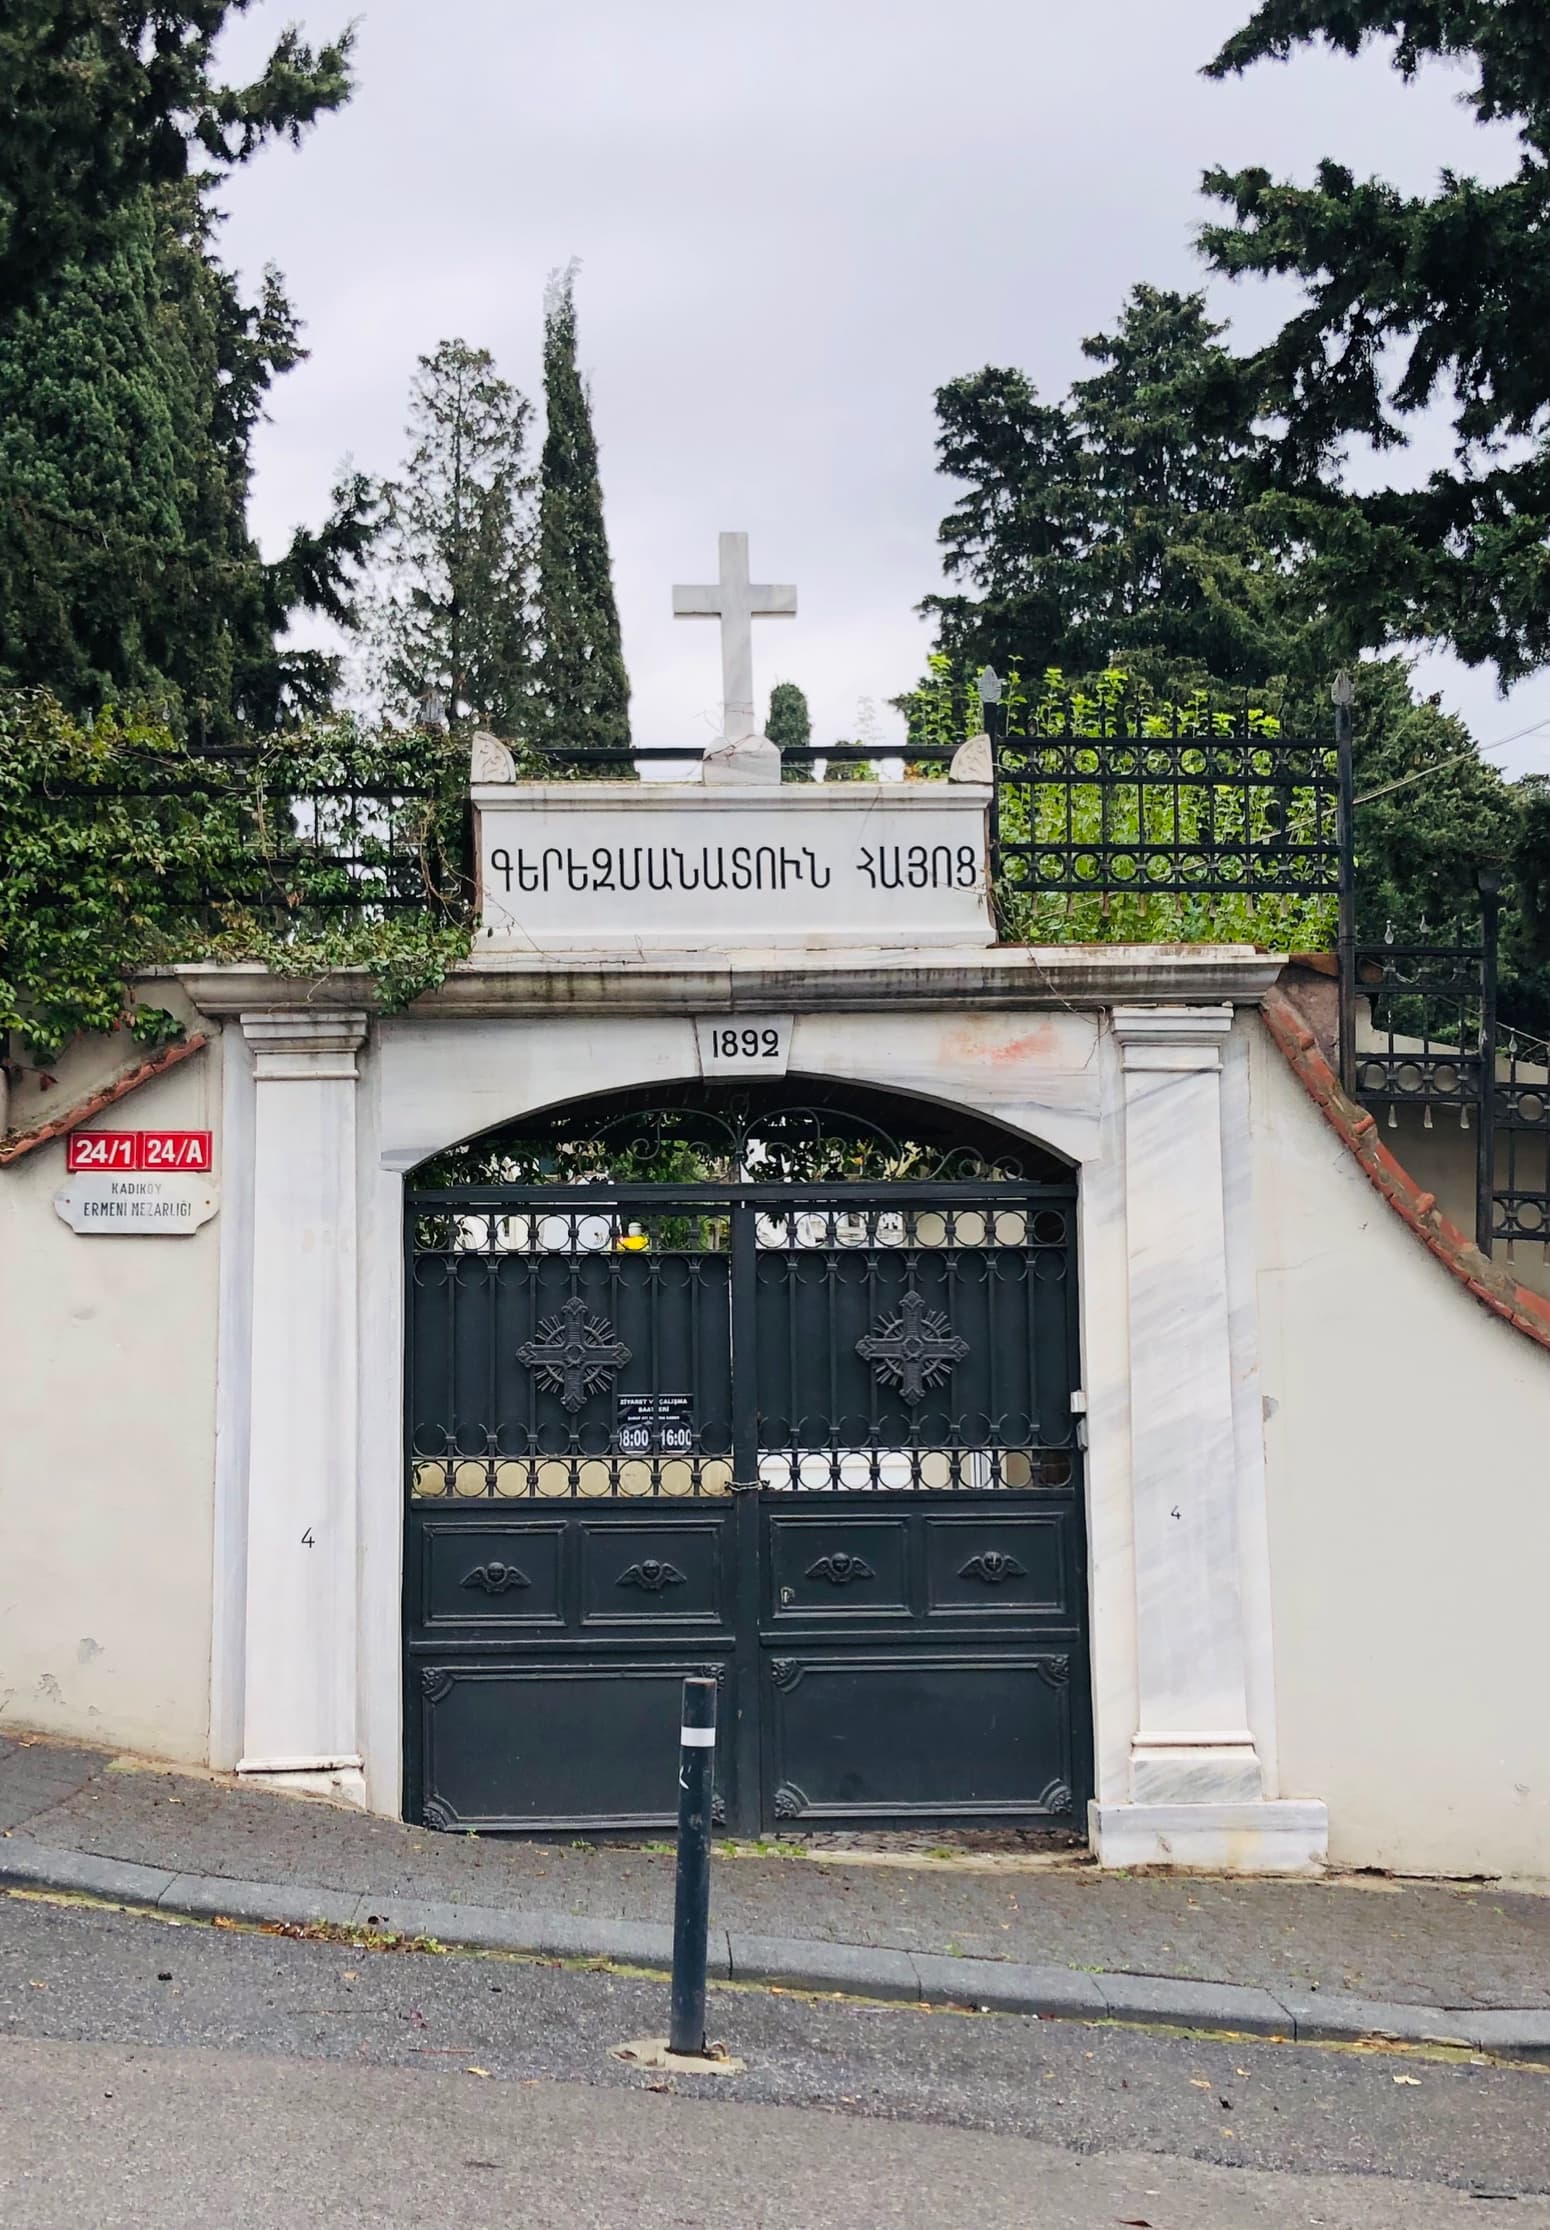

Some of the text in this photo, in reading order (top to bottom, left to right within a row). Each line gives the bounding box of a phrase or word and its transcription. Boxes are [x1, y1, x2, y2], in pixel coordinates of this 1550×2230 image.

[491, 846, 977, 892] ԳԵՐԵԶՄԱՆԱՏՈՒՆ ՀԱՅՈՑ
[713, 1029, 779, 1058] 1892
[75, 1139, 132, 1165] 24/1
[147, 1139, 204, 1166] 24/A
[301, 1527, 315, 1549] 4
